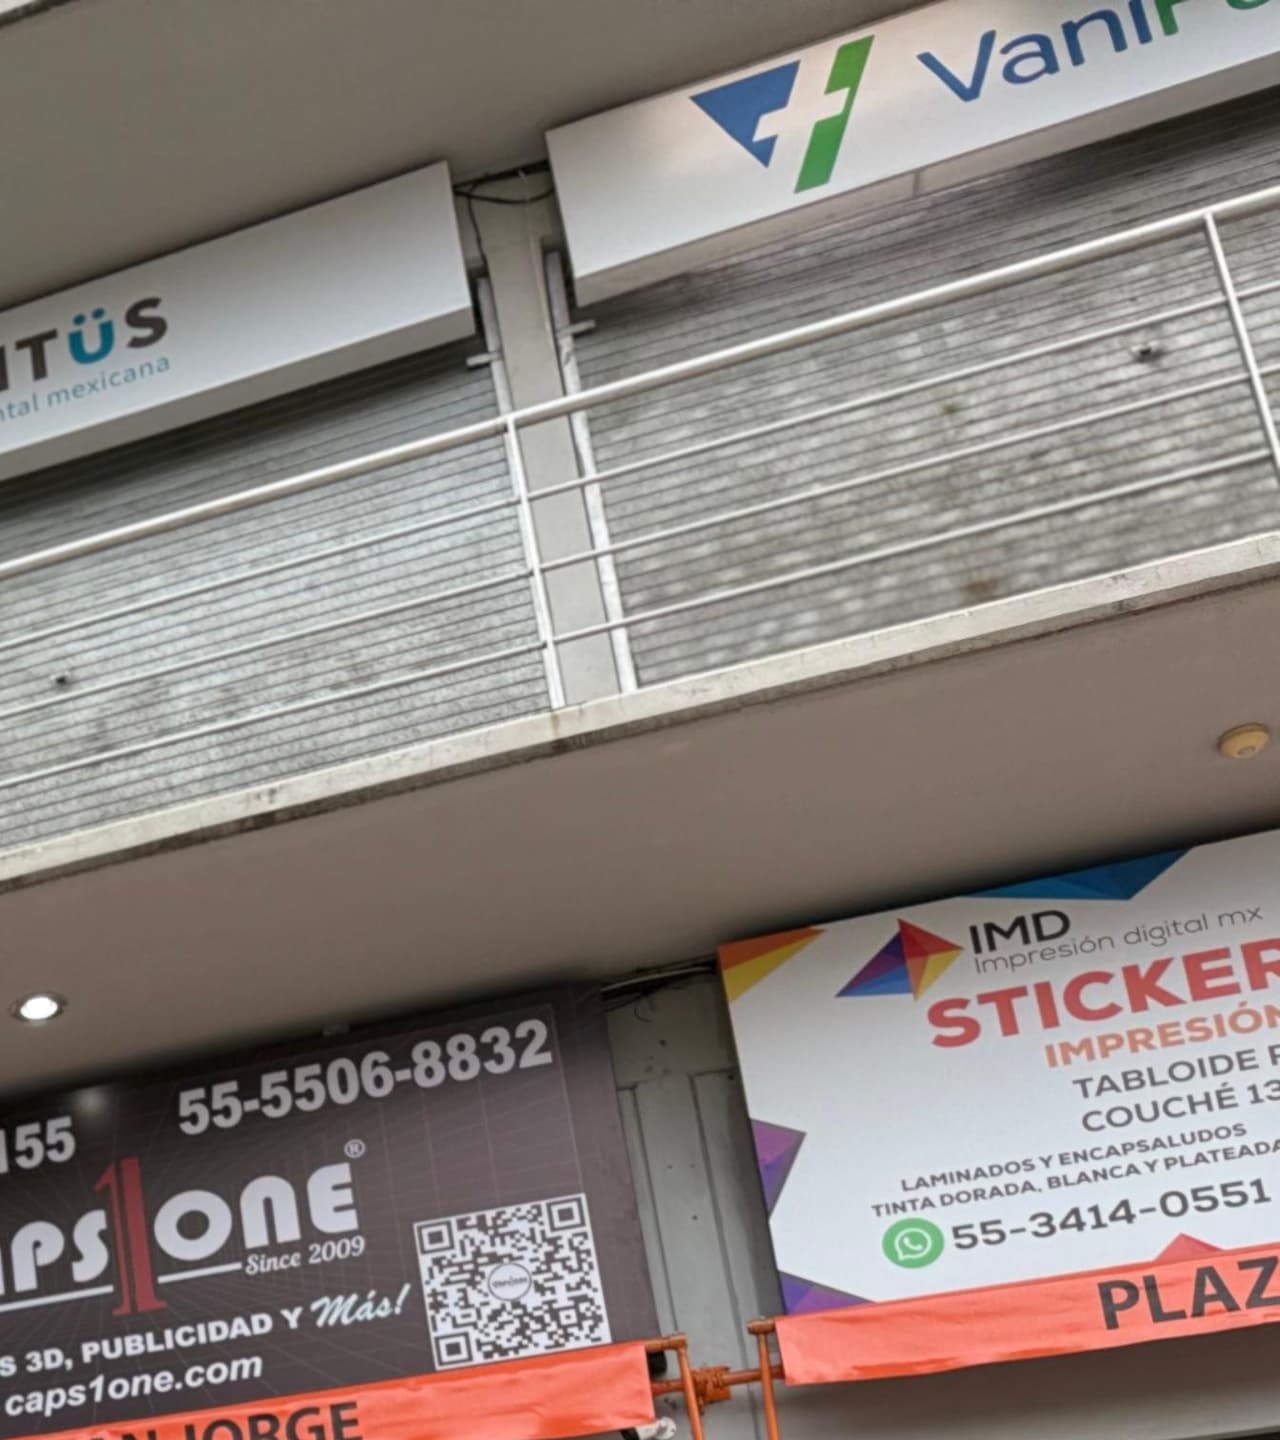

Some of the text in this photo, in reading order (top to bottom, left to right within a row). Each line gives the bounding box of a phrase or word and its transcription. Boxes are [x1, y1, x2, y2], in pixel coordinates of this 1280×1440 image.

[46, 353, 172, 408] mexicana
[968, 909, 1071, 955] IMD
[974, 906, 1264, 975] Impresión digital mx
[177, 1018, 553, 1137] 55-5506-8832
[1072, 1048, 1260, 1100] TABLOIDE
[1081, 1081, 1240, 1133] COUCHÉ
[871, 1196, 936, 1217] TINTA
[1047, 1163, 1142, 1190] BLANCA
[1144, 1159, 1159, 1173] Y
[901, 1123, 1248, 1192] LAMINADOS Y ENCAPSALUDOS
[952, 1177, 1272, 1250] 55-3414-0551
[245, 1235, 366, 1276] Since 2009
[25, 1348, 73, 1373] 3D,
[81, 1312, 273, 1364] PUBLICIDAD
[280, 1306, 303, 1330] Y
[311, 1283, 411, 1328] Más!
[5, 1355, 263, 1419] caps1one.com
